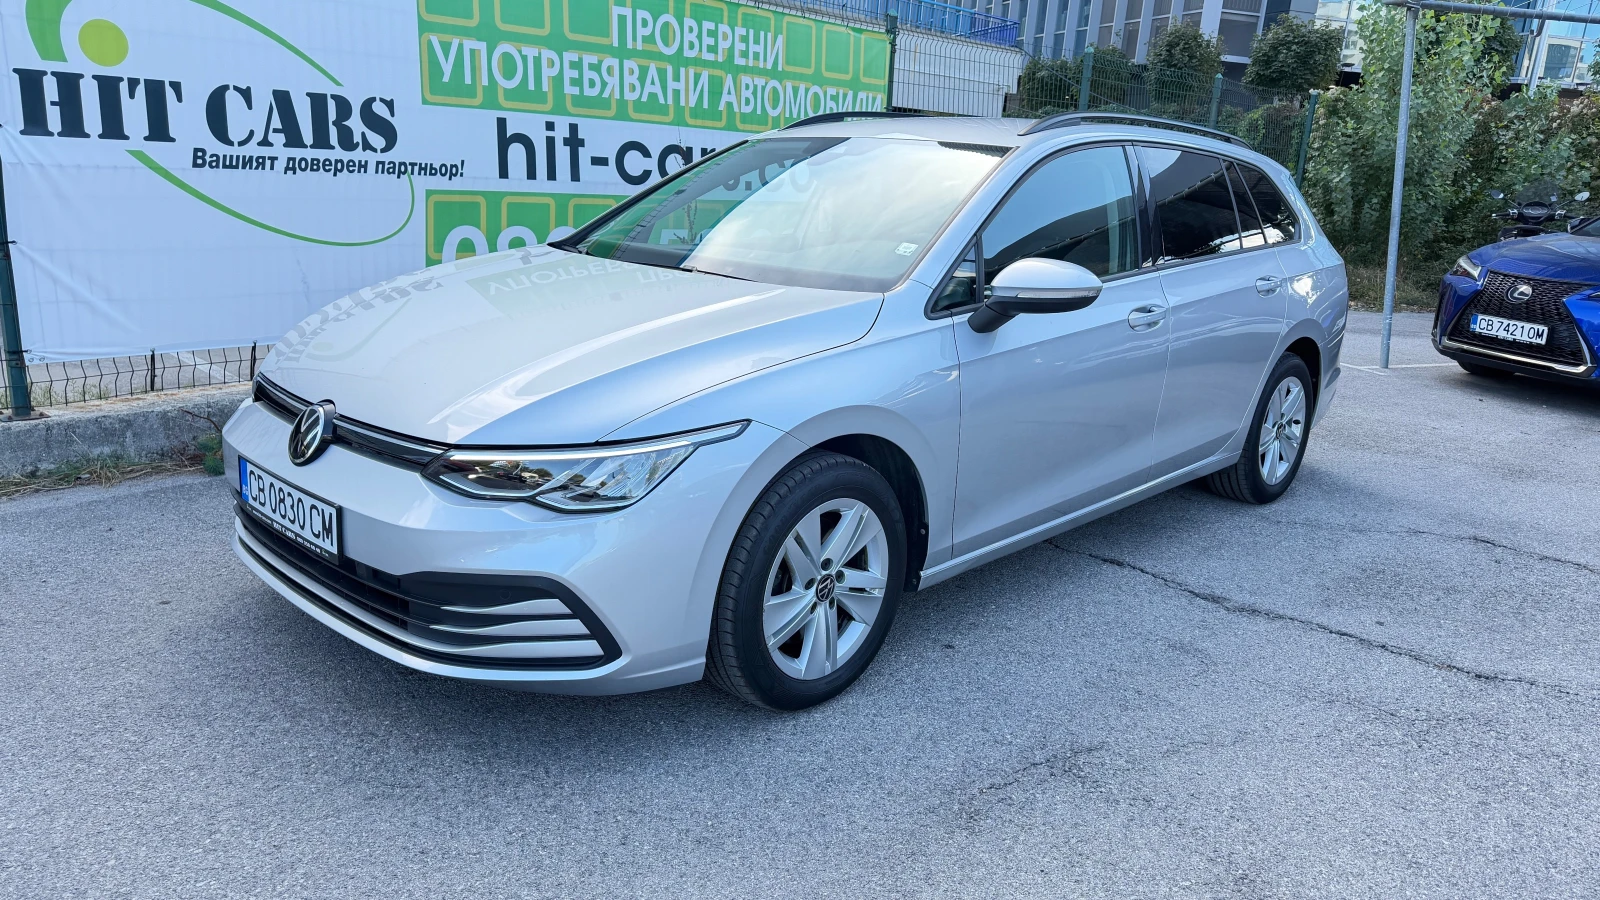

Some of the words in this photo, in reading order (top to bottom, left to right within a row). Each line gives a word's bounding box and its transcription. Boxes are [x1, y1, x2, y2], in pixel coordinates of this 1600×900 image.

[611, 5, 783, 72] ПРОВЕРЕНИ
[12, 67, 183, 142] HIT
[205, 84, 398, 153] CARS
[429, 35, 709, 109] УПОТРЕБЯВАНИ
[718, 73, 882, 119] АВТОМОБИЛИ
[191, 147, 278, 171] Вашият
[284, 156, 368, 177] доверен
[375, 159, 465, 180] партньор!
[1478, 317, 1494, 332] CB
[1495, 320, 1525, 338] 7421
[1527, 326, 1545, 342] OM
[249, 469, 266, 507] CB
[269, 481, 306, 531] 0830
[310, 503, 334, 547] CM
